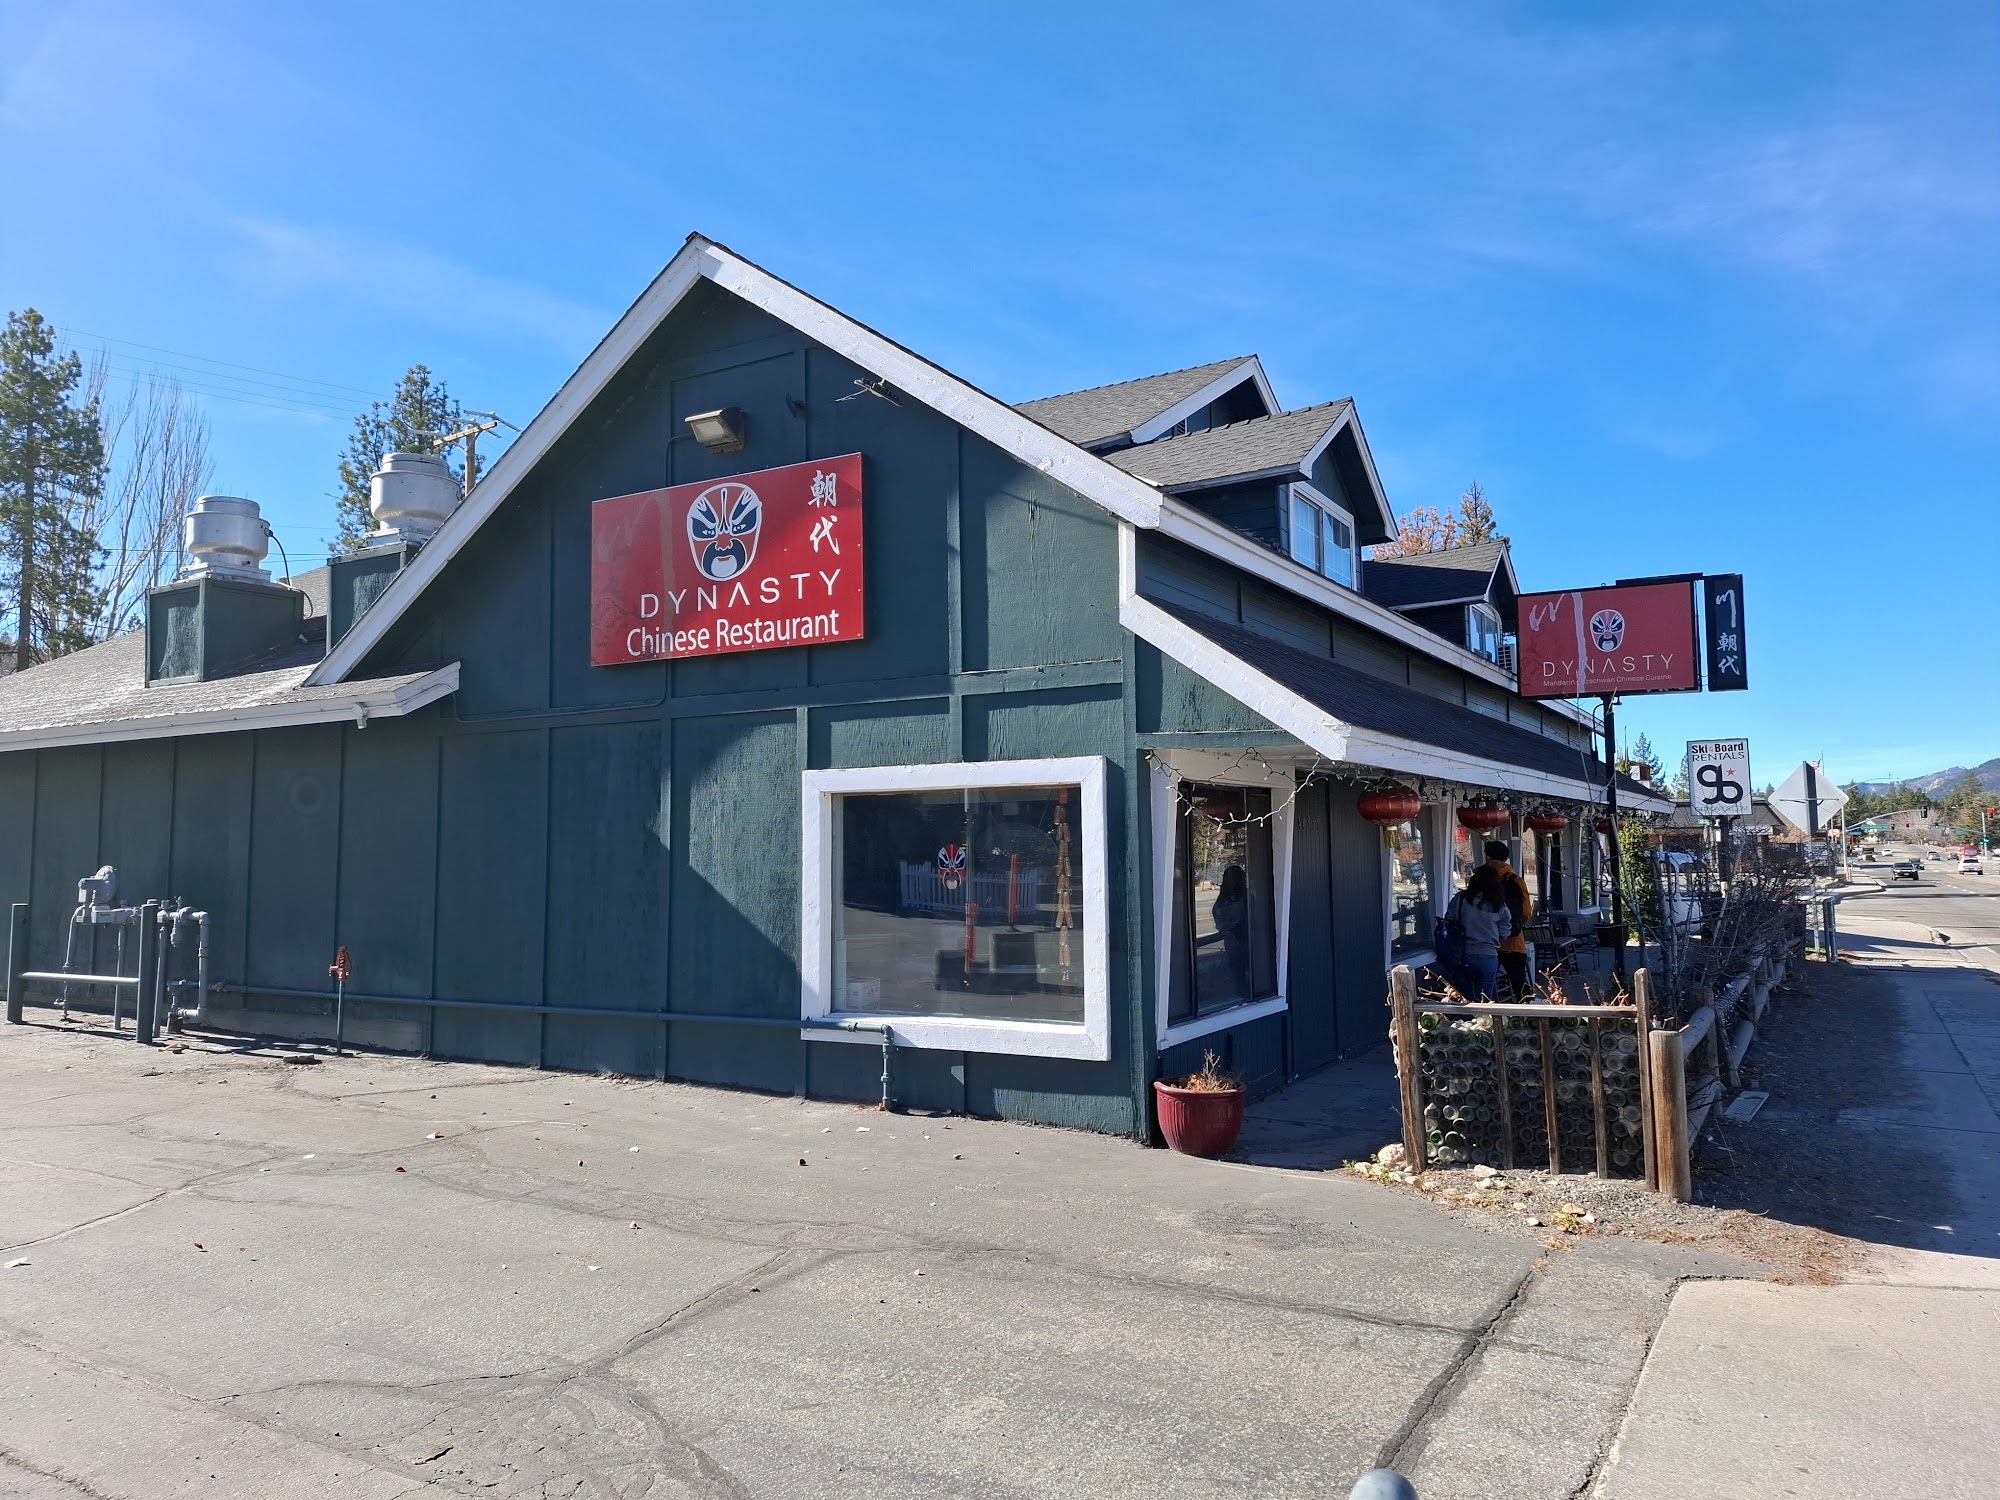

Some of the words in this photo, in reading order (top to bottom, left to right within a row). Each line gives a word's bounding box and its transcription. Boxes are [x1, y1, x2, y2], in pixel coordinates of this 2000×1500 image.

[640, 568, 841, 619] DYNASTY
[627, 625, 709, 657] Chinese
[716, 608, 840, 648] Restaurant
[1543, 653, 1674, 677] DYNASTY
[1543, 679, 1576, 687] Mandarin
[1582, 677, 1616, 685] zechwan
[1616, 674, 1645, 683] Chinese
[1645, 673, 1672, 681] Cuisine
[1692, 744, 1708, 754] Ski
[1714, 742, 1744, 752] Board
[1692, 752, 1745, 762] RENTALS
